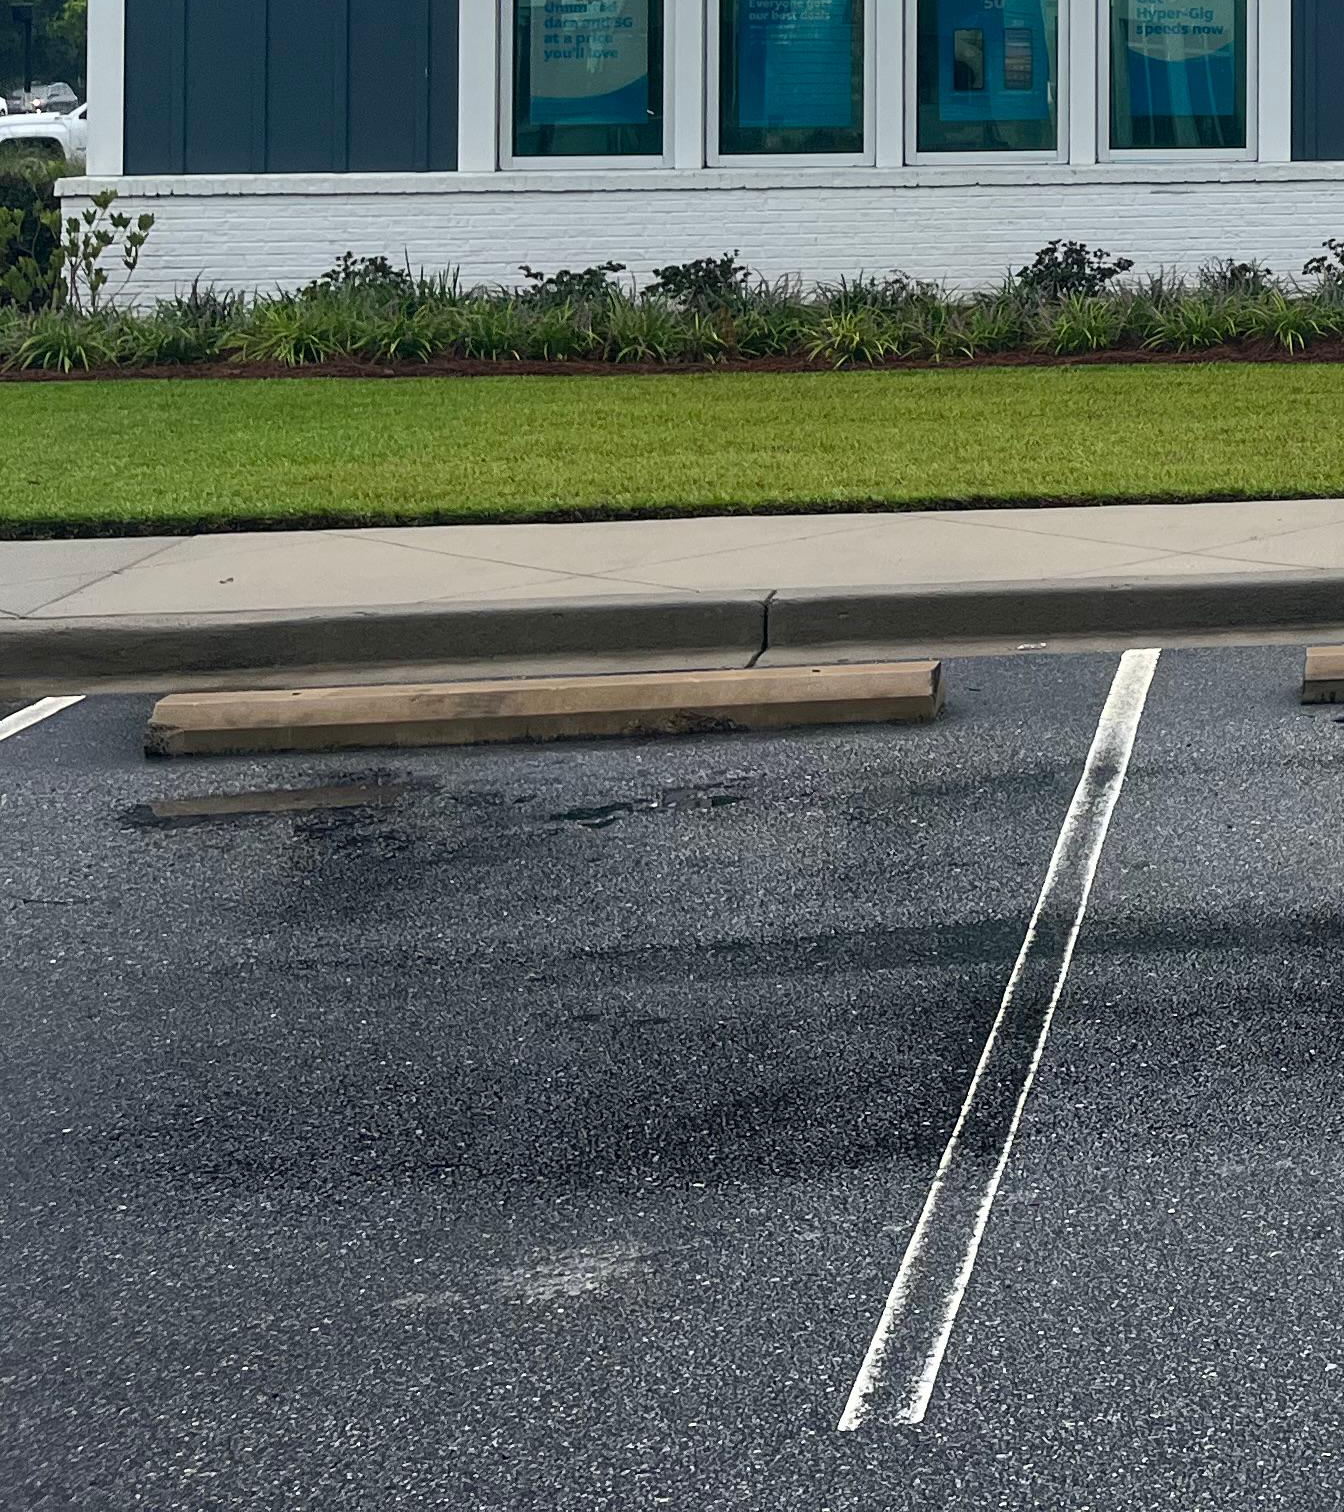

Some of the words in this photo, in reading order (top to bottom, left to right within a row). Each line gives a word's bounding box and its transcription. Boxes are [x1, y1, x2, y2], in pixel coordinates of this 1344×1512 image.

[1135, 5, 1216, 23] Hyper-Gig
[1135, 21, 1189, 37] speeds
[1191, 24, 1225, 35] now
[543, 32, 560, 45] at
[563, 34, 573, 45] a
[543, 47, 585, 63] you'll
